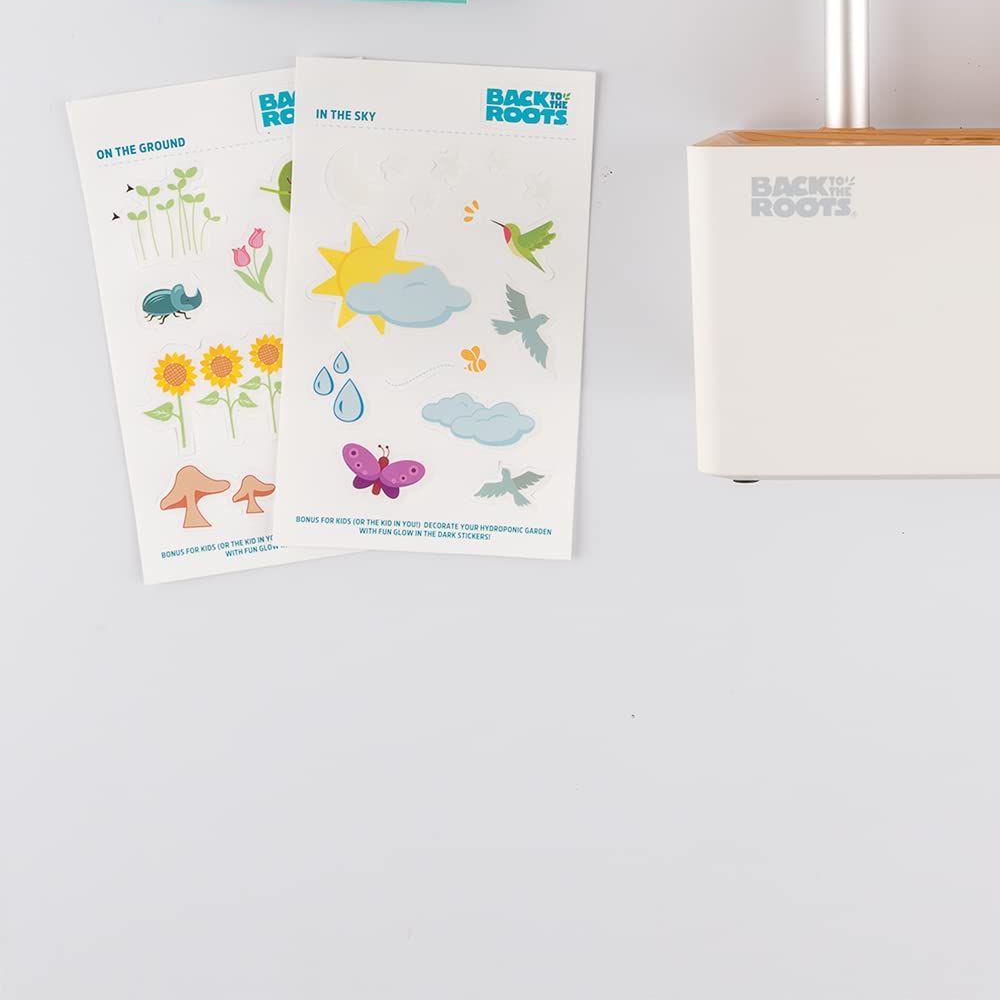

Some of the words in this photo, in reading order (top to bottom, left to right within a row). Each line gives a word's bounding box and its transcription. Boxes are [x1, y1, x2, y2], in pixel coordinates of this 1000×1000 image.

[259, 90, 295, 111] BA
[486, 88, 550, 108] BACK
[550, 92, 562, 100] TO
[550, 101, 568, 109] THE
[316, 109, 328, 119] IN
[330, 110, 351, 120] THE
[354, 111, 376, 121] SKY
[486, 106, 568, 125] ROOTS
[96, 148, 113, 160] ON
[115, 145, 136, 157] THE
[139, 137, 186, 153] GROUND
[751, 176, 829, 197] BACK
[829, 176, 845, 186] TO
[829, 186, 852, 197] THE
[751, 197, 852, 218] ROOTS
[424, 521, 459, 530] DECORATE
[480, 524, 523, 534] HYDROPONIC
[524, 527, 552, 535] GARDEN
[458, 532, 491, 540] STICKERS!
[161, 549, 185, 559] BONUS
[186, 547, 199, 555] FOR
[200, 544, 216, 552] KIDS
[217, 542, 230, 551] (OR
[231, 539, 244, 547] THE
[245, 537, 256, 545] KID
[225, 548, 244, 557] WITH
[244, 546, 258, 554] FUN
